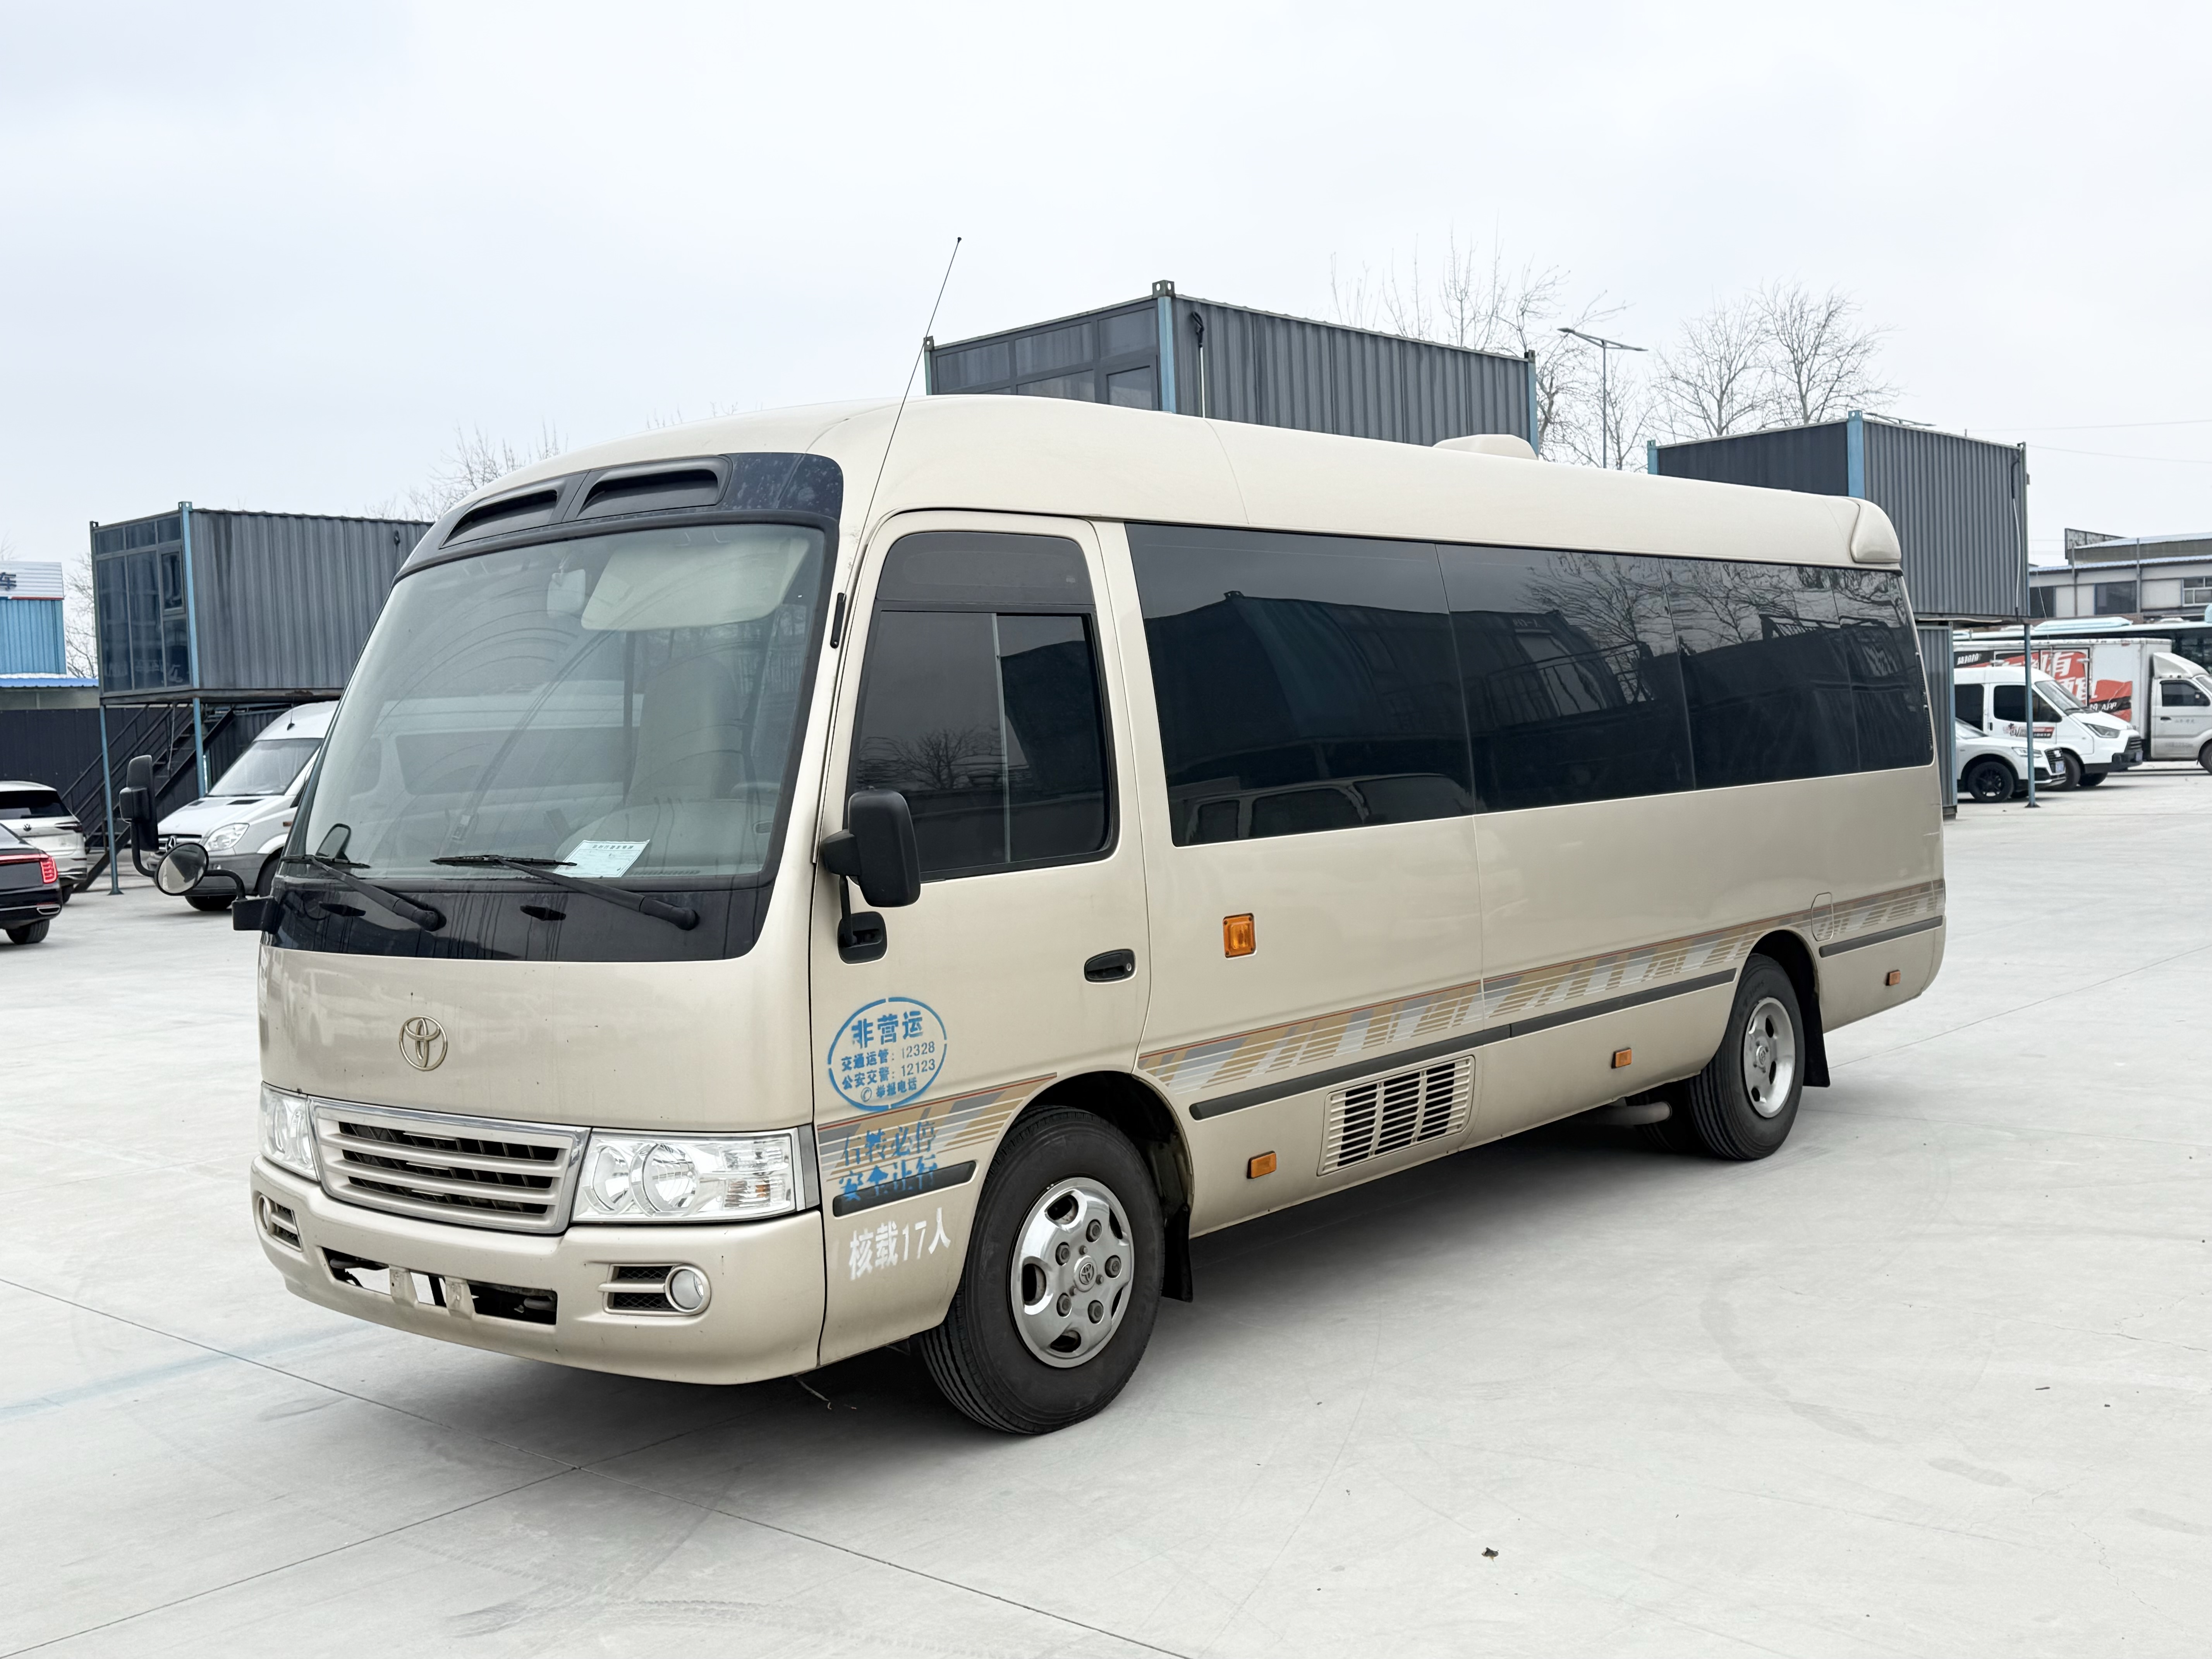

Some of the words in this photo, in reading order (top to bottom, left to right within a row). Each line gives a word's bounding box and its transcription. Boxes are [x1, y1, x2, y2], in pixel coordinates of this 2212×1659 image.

[851, 1011, 924, 1049] 非营运
[876, 1077, 917, 1098] 举报电话
[839, 1154, 938, 1201] 安全让行
[849, 1207, 951, 1281] 核载17人
